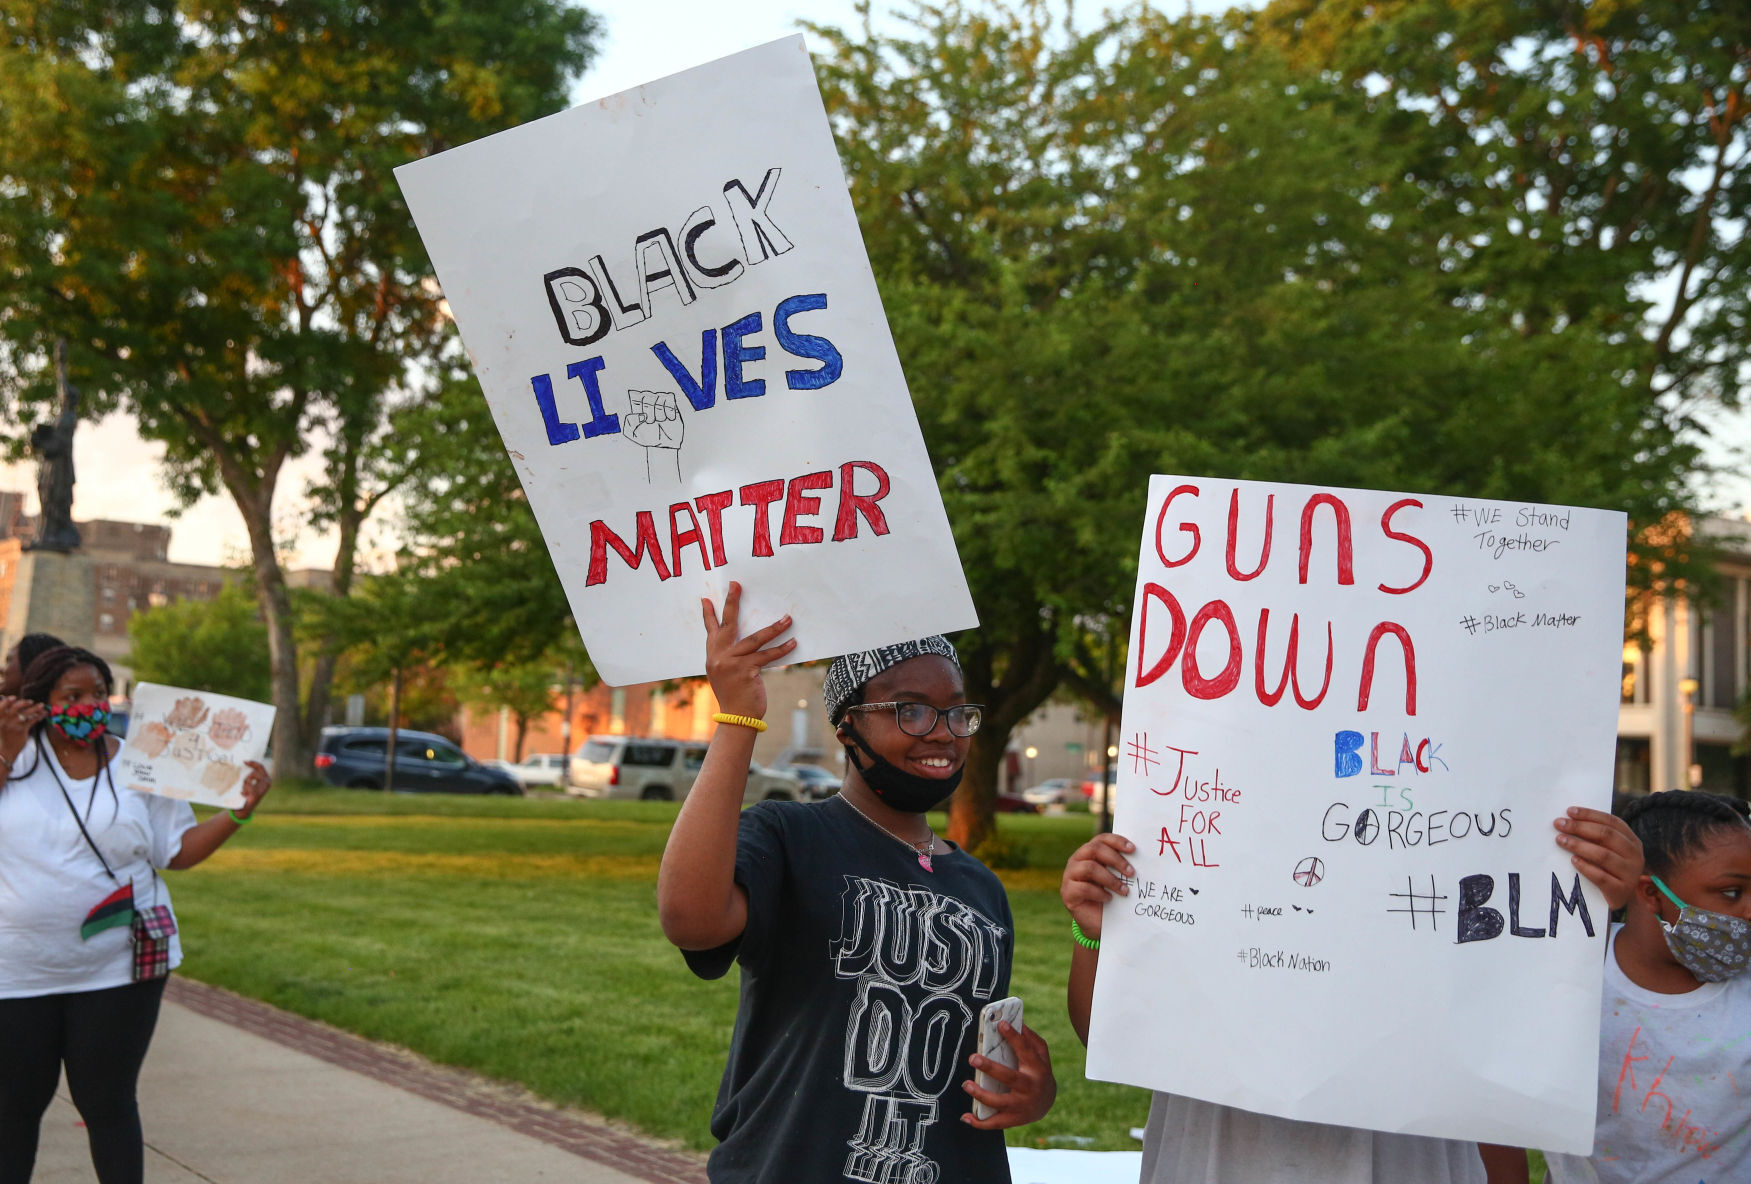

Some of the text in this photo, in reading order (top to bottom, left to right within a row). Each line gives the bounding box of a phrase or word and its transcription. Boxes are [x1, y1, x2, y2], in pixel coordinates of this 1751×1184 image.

[544, 167, 795, 347] BLACK
[585, 460, 891, 588] MATTER
[1450, 503, 1571, 531] #WE Stand
[1473, 530, 1560, 560] Together
[1460, 611, 1582, 635] #Black Matter
[1334, 730, 1449, 778] BLACK
[1372, 785, 1414, 812] IS
[1178, 804, 1222, 835] FOR
[1322, 802, 1512, 850] GORGEOUS
[1156, 826, 1220, 867] ALL
[1161, 884, 1184, 902] ARE
[1386, 871, 1596, 945] #BLM
[1134, 902, 1195, 926] GORGEOUS
[829, 875, 1006, 1000] JUST
[1237, 947, 1331, 973] #Black Nation
[843, 973, 973, 1099] DO
